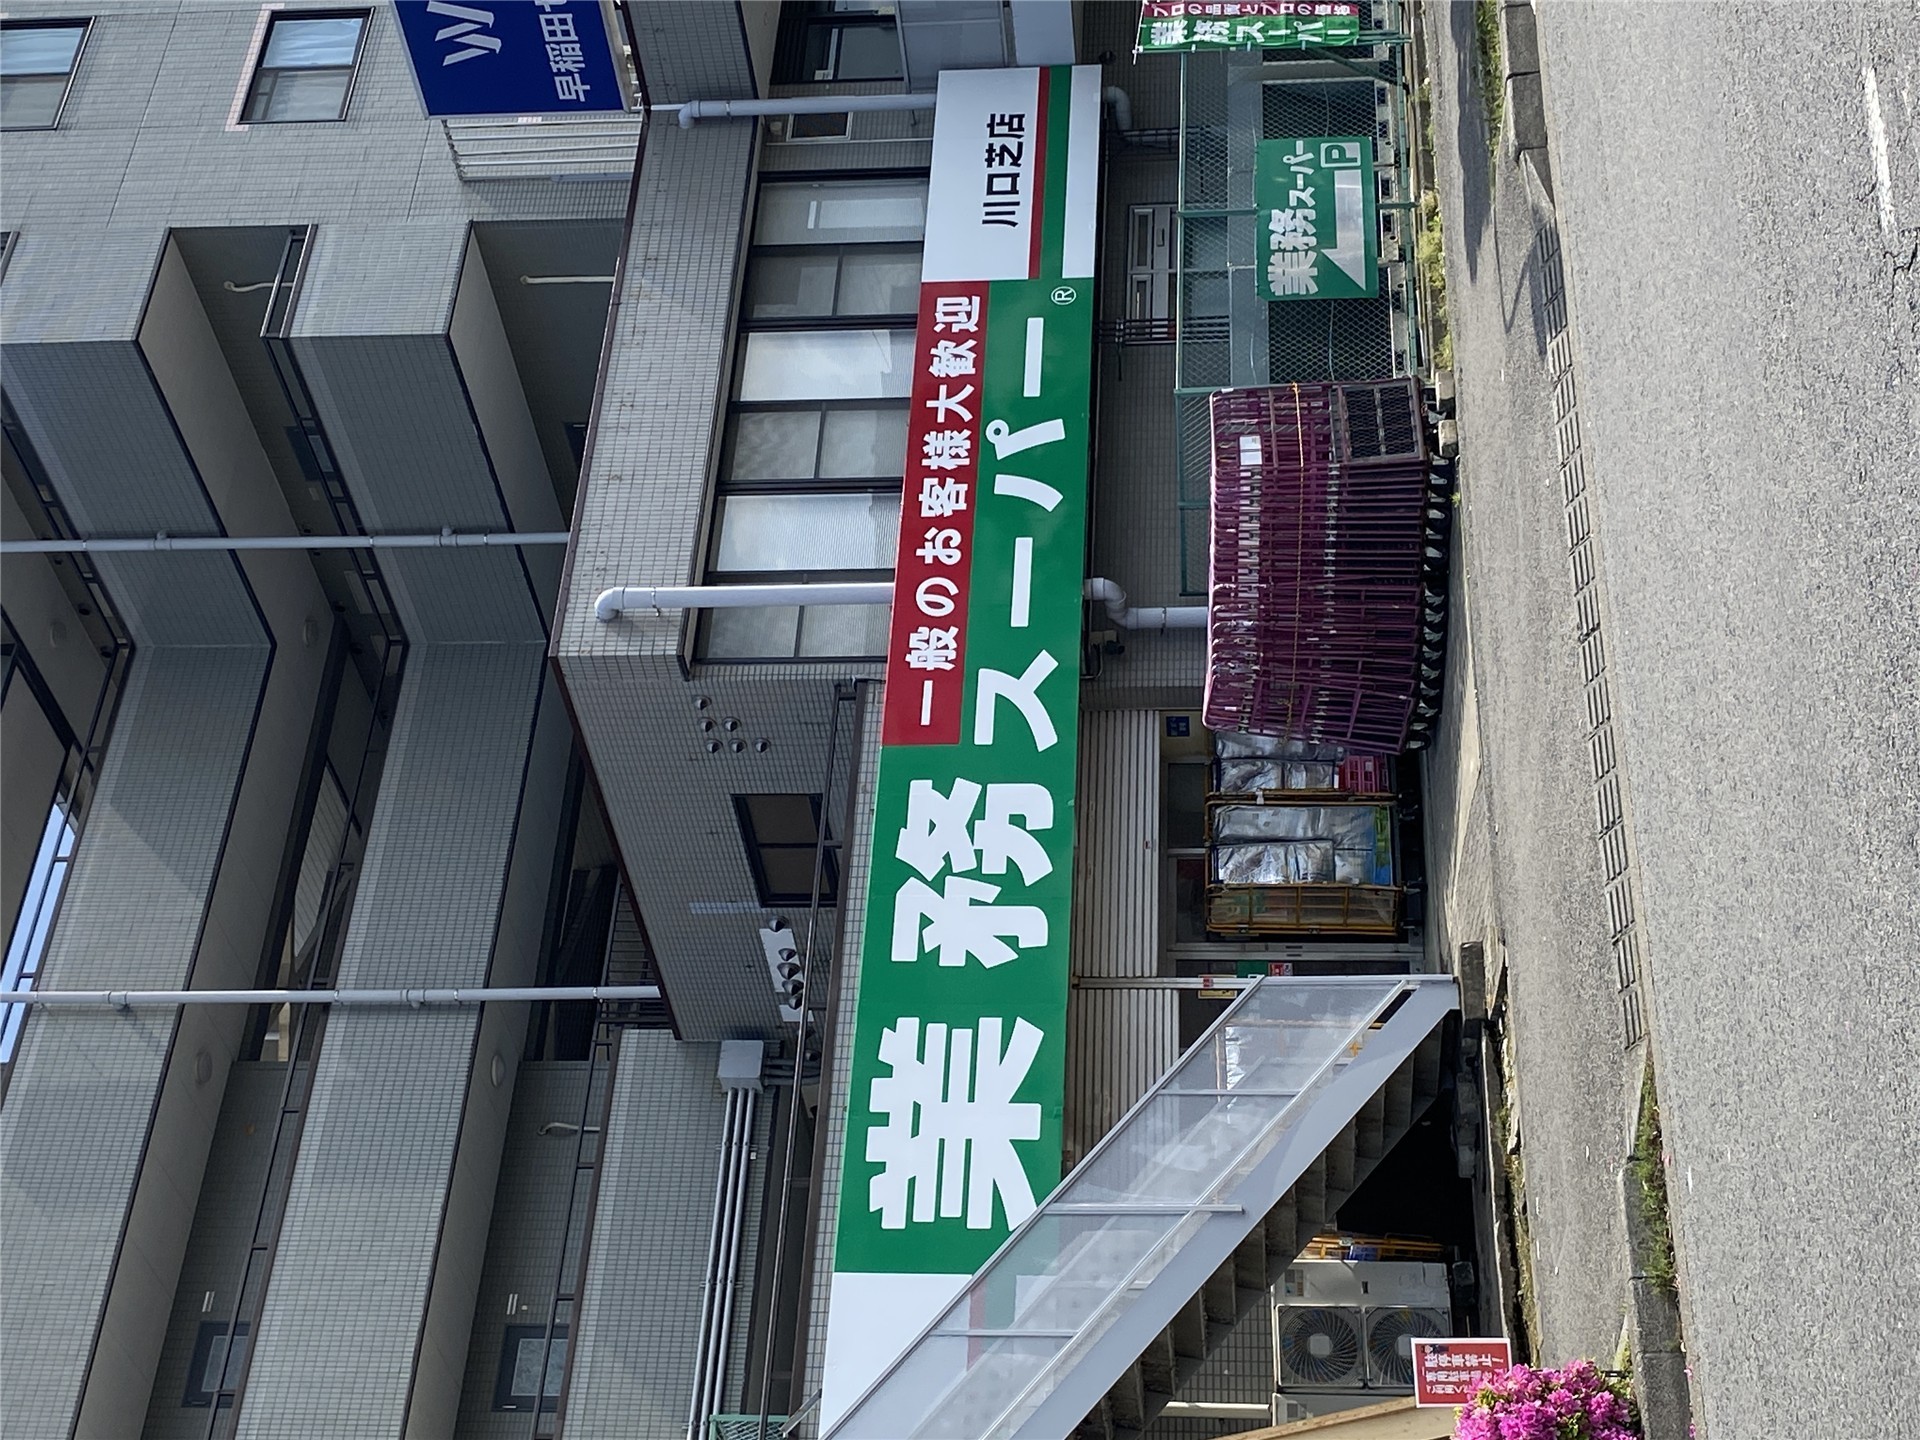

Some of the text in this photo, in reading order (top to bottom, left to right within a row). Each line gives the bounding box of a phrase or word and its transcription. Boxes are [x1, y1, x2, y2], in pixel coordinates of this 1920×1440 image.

[1150, 19, 1351, 46] 業務スーパー
[981, 113, 1026, 228] 川口芝店
[1267, 140, 1319, 296] 業務スーパー
[905, 295, 981, 727] 一般のお客様大歓迎
[865, 316, 1066, 1232] 業務スーパー
